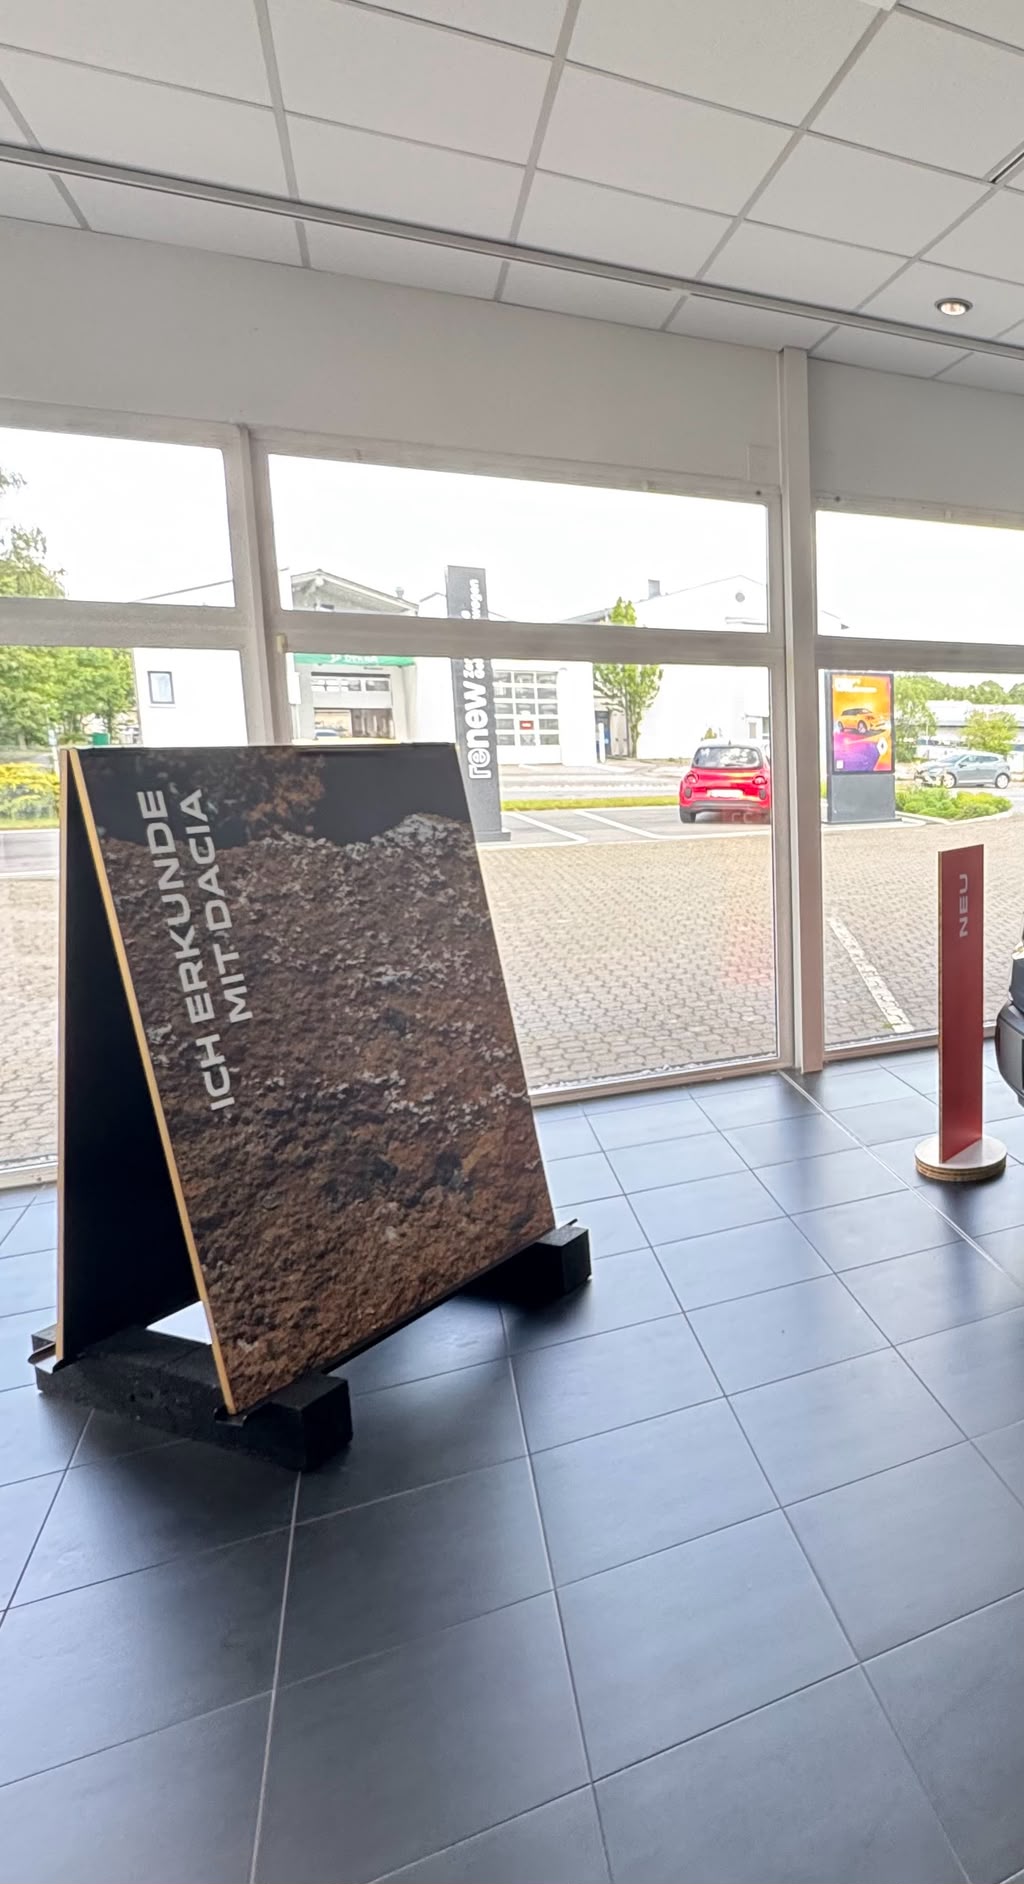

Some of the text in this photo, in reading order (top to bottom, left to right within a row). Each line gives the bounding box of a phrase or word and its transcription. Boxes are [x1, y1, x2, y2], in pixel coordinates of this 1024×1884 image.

[463, 681, 492, 779] renew
[137, 790, 235, 1111] ICH ERKUNDE
[179, 788, 253, 1024] MIT DACIA
[959, 873, 969, 938] NEU
